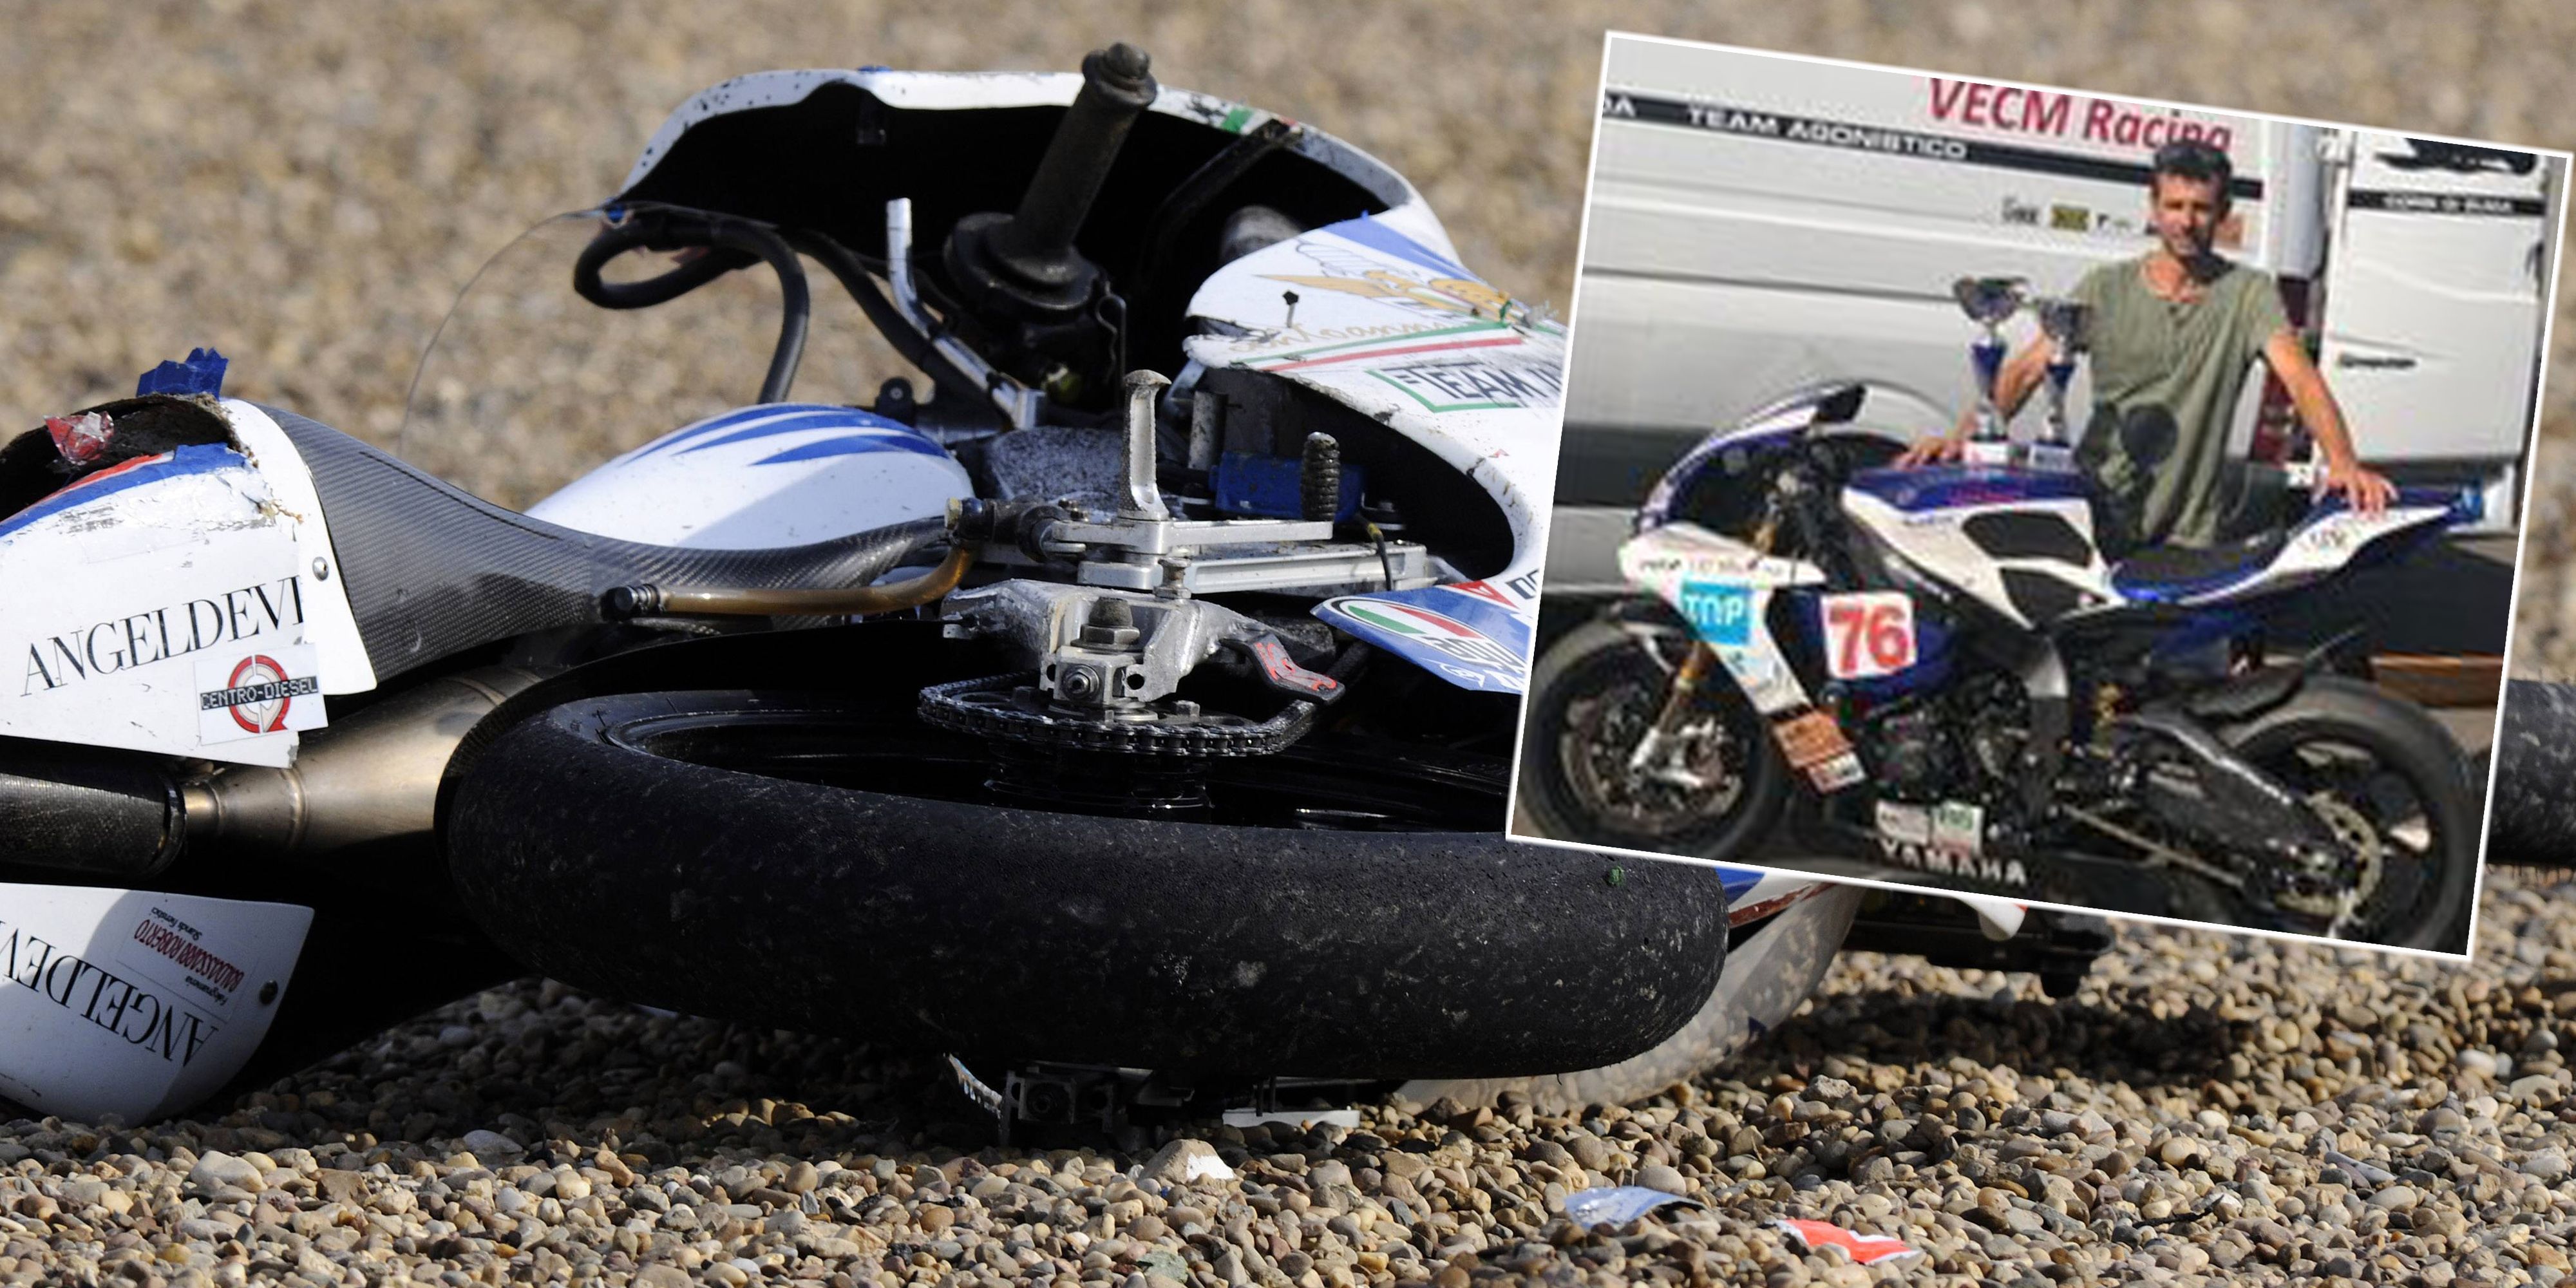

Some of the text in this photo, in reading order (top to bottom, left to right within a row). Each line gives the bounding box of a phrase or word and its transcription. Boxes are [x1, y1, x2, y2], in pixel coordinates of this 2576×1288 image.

[1687, 107, 1780, 136] TEAM
[1931, 77, 2071, 135] VECM
[1829, 604, 1911, 674] 76
[1878, 838, 2028, 887] YAMAHA
[134, 919, 186, 960] ROBERTO
[0, 921, 220, 1067] ANGELDEV
